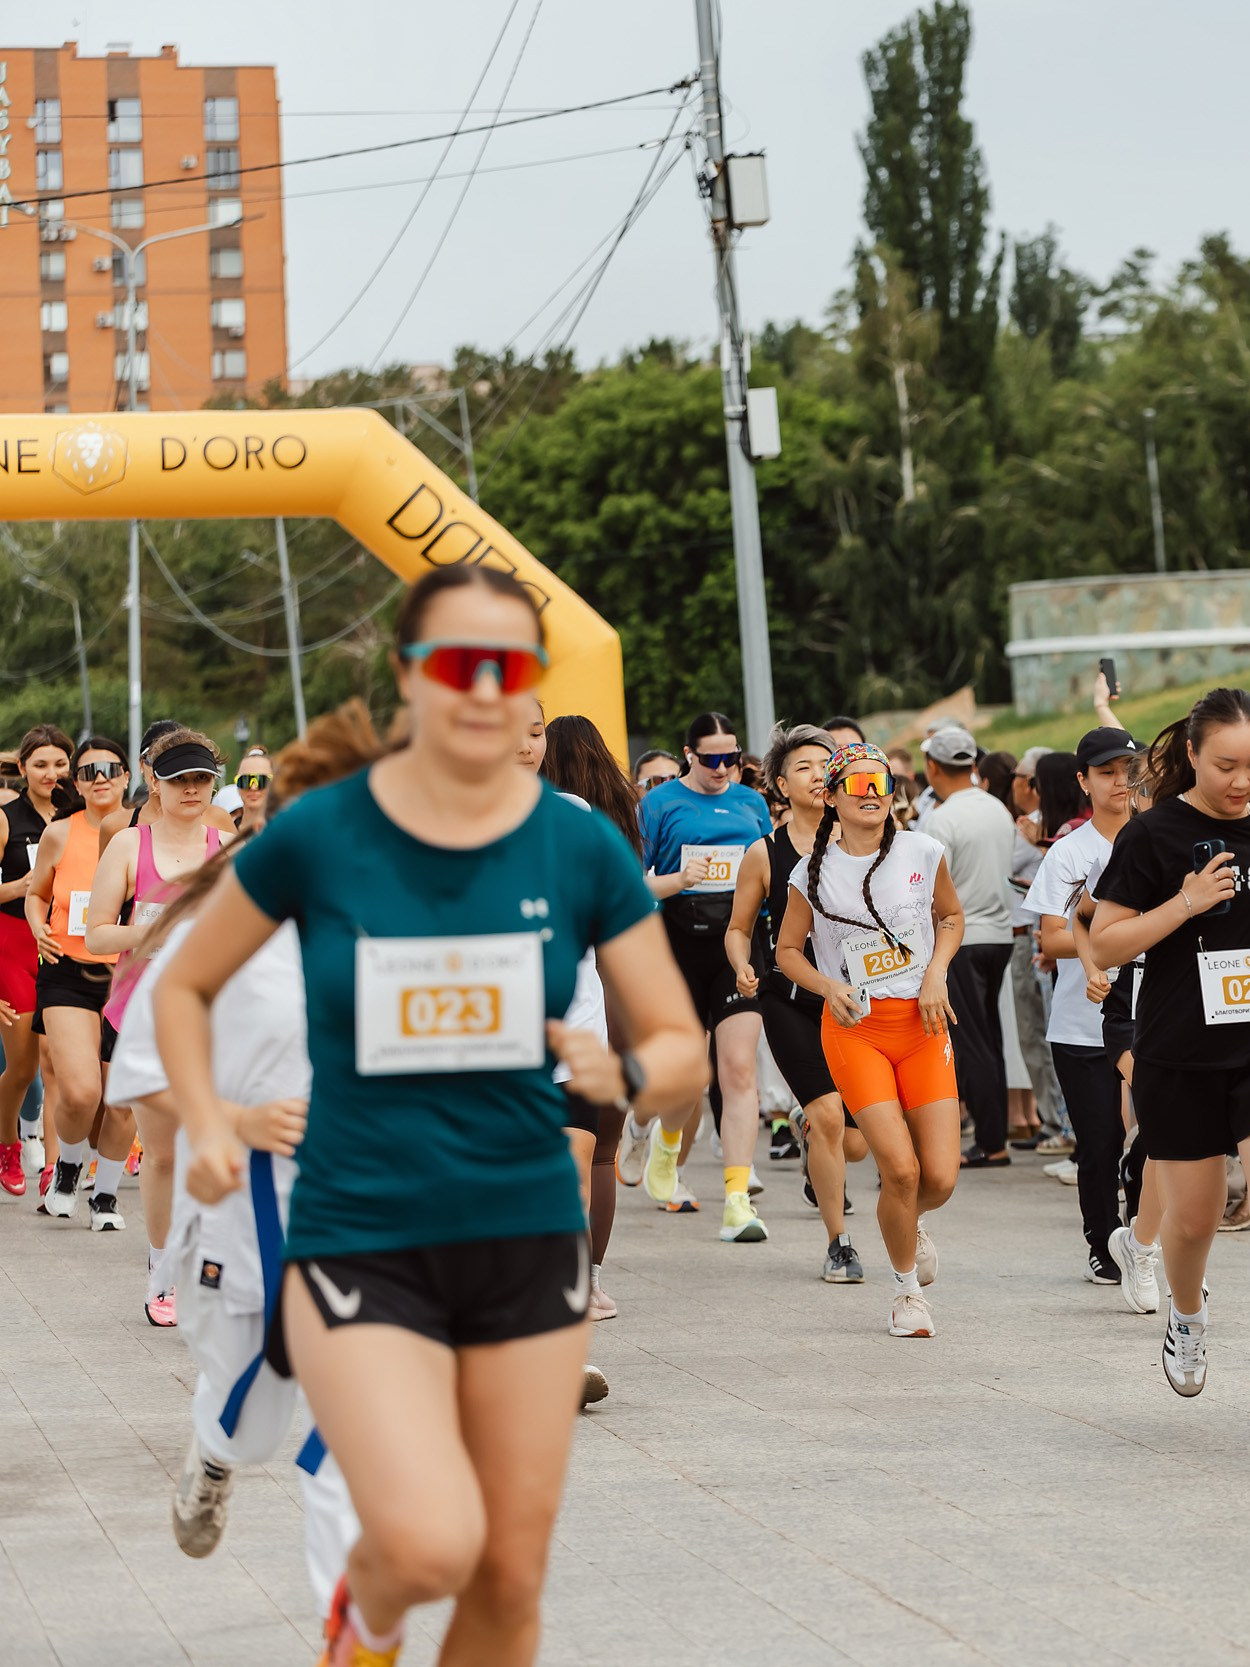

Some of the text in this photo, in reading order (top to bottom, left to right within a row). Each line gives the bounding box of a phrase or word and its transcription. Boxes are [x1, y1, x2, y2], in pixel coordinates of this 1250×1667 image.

[161, 434, 307, 470] D'ORO
[705, 863, 728, 879] 80
[850, 940, 878, 952] LEONE
[868, 949, 905, 973] 260
[1207, 959, 1240, 970] LEONE
[407, 990, 495, 1032] 023
